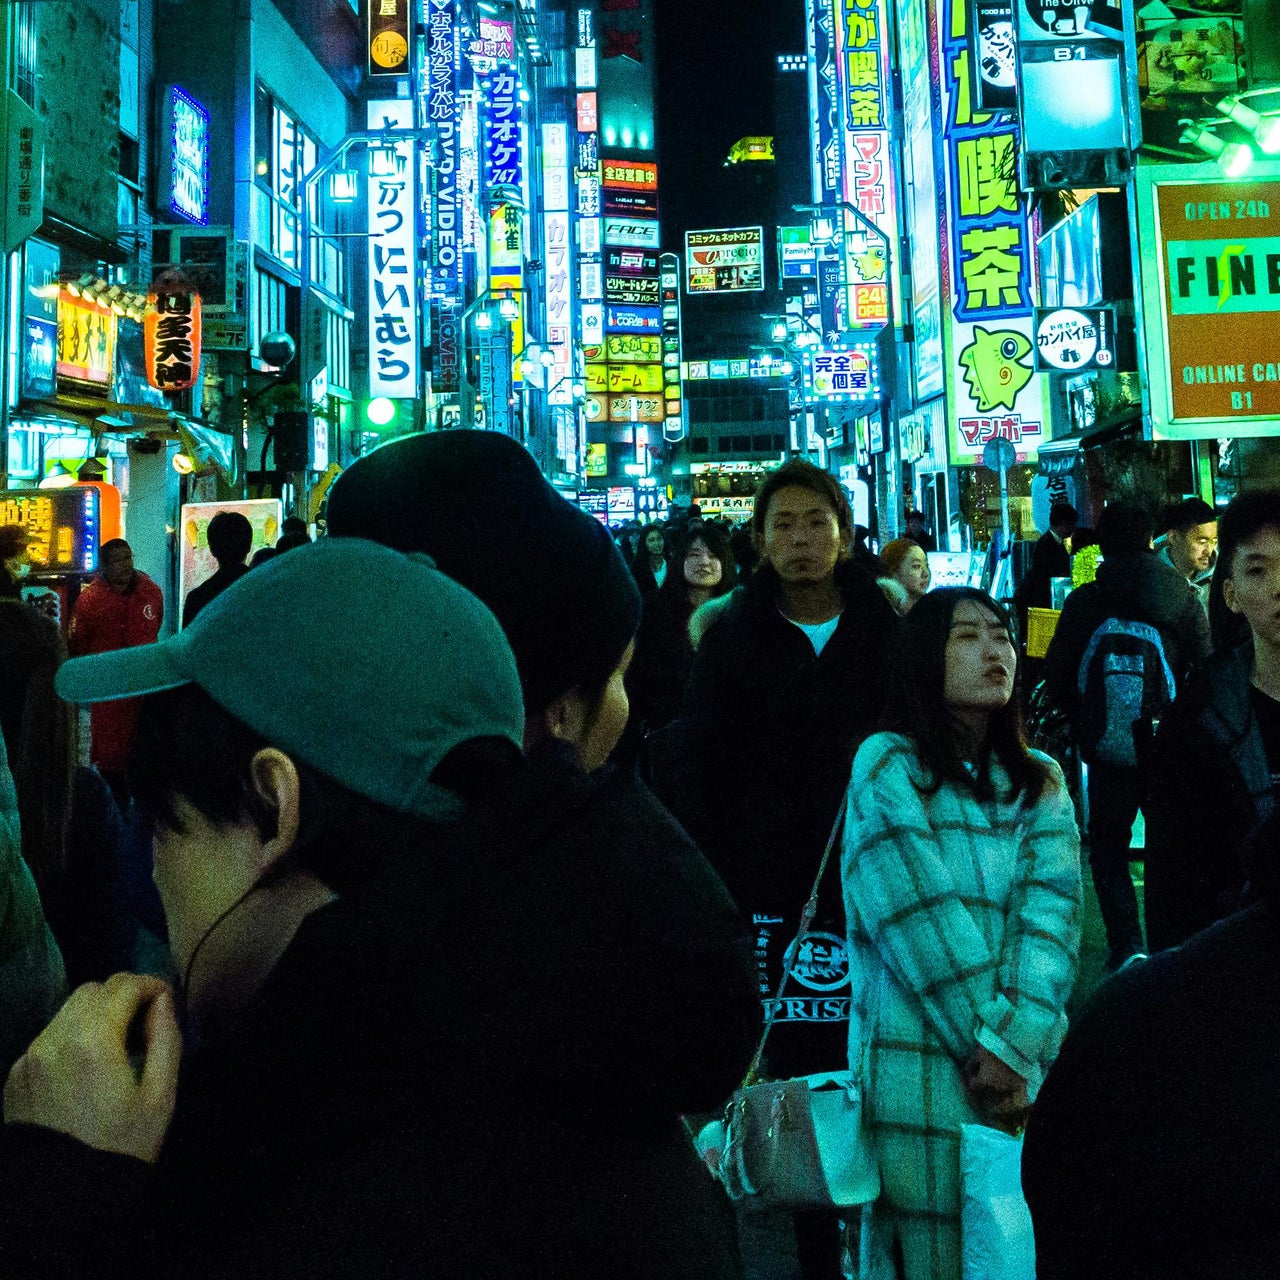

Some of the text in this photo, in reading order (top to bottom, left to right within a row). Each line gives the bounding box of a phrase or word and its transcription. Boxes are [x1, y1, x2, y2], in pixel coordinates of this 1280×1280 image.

[1054, 48, 1087, 60] B1
[430, 11, 454, 119] ホテルがライバル
[491, 73, 517, 166] カラオケ
[492, 169, 517, 183] 747
[590, 179, 598, 213] カラオケ
[1185, 200, 1269, 220] OPEN 24h
[504, 205, 520, 251] 麻雀
[607, 225, 657, 235] FACE
[375, 114, 412, 382] とかつにいむら
[784, 248, 816, 256] FamilyM
[548, 219, 568, 318] カラオケ
[815, 356, 851, 373] 完全
[610, 373, 642, 387] ゲーム
[832, 373, 868, 390] 個室
[1183, 365, 1246, 384] ONLINE
[1231, 391, 1253, 410] B1
[959, 415, 1041, 447] マンボー
